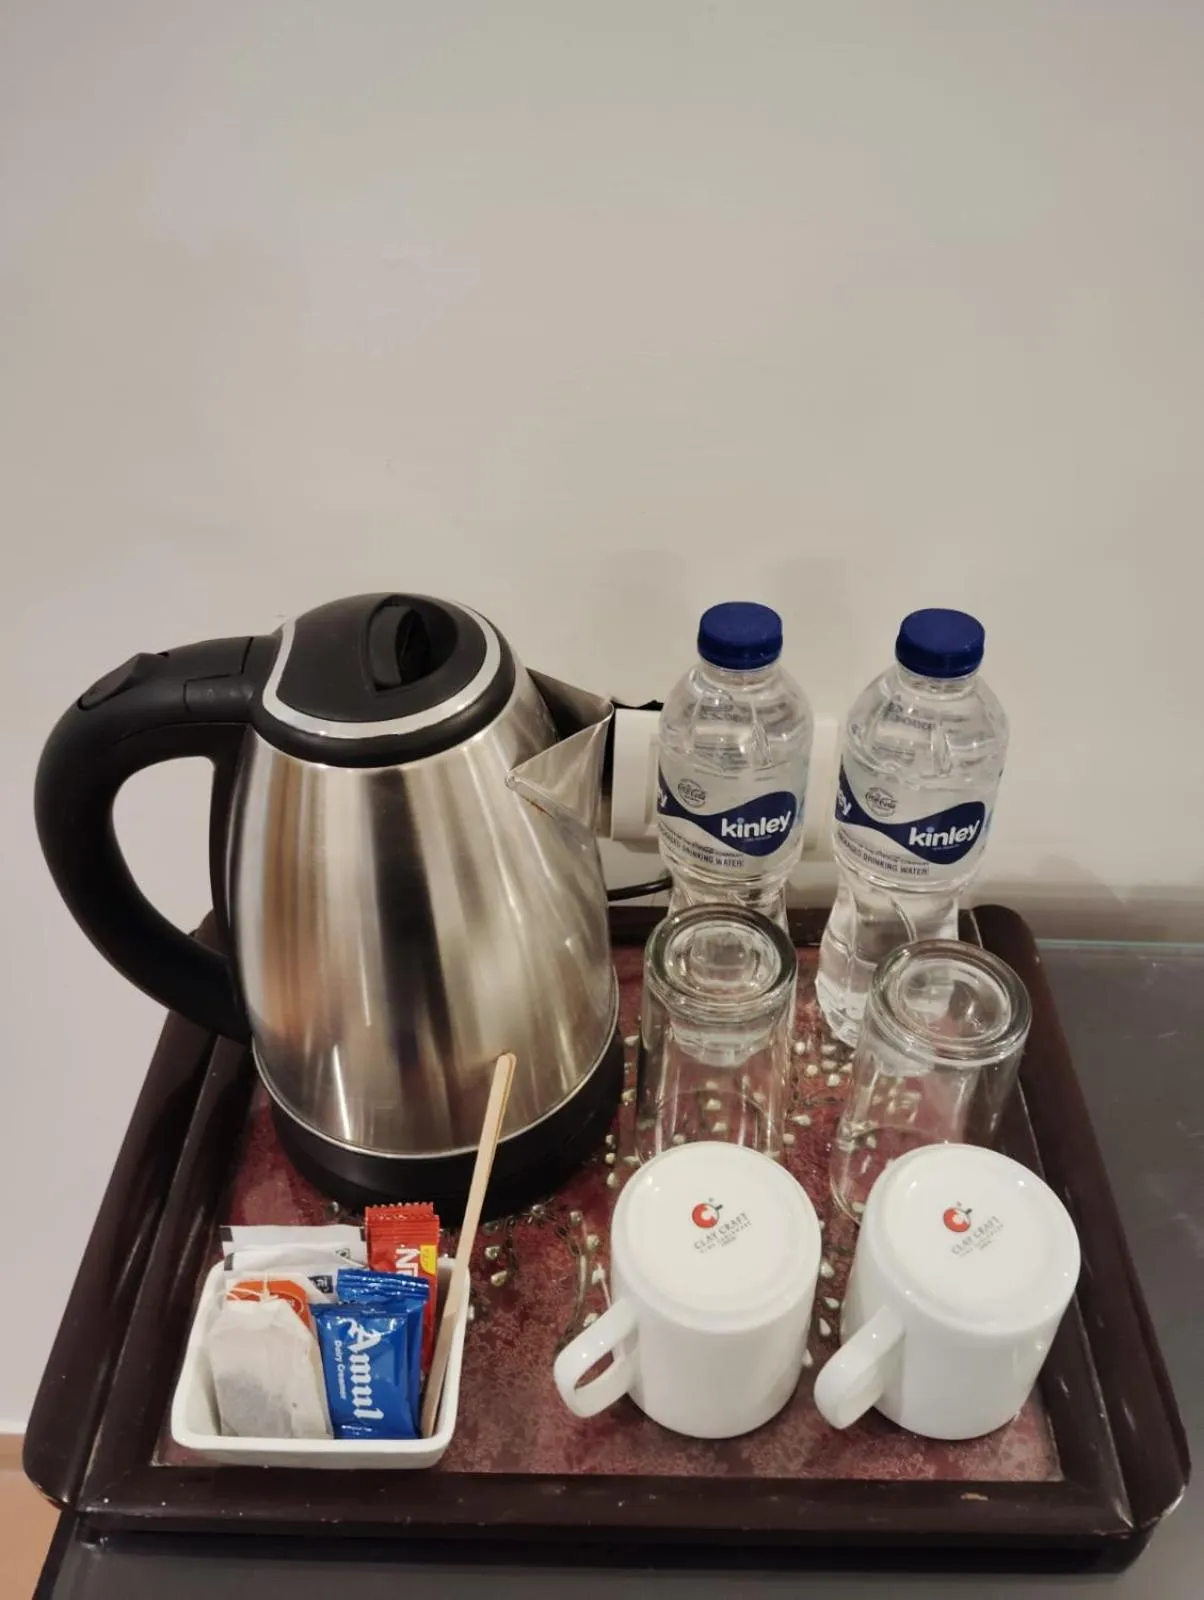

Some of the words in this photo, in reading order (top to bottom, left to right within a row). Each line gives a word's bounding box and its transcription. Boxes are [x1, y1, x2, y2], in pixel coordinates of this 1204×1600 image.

[721, 810, 792, 838] kinley
[909, 819, 981, 847] kinley
[682, 844, 714, 865] DRINKING
[715, 857, 744, 868] WATER
[863, 850, 898, 872] DRINKING
[900, 865, 930, 876] WATER
[694, 1231, 719, 1250] CLAY
[719, 1212, 749, 1234] CRAFT
[951, 1236, 973, 1255] CLAY
[973, 1215, 1000, 1239] CRAFT
[333, 1339, 344, 1363] Dairy
[336, 1363, 348, 1401] Creamer
[338, 1317, 385, 1420] Amul
